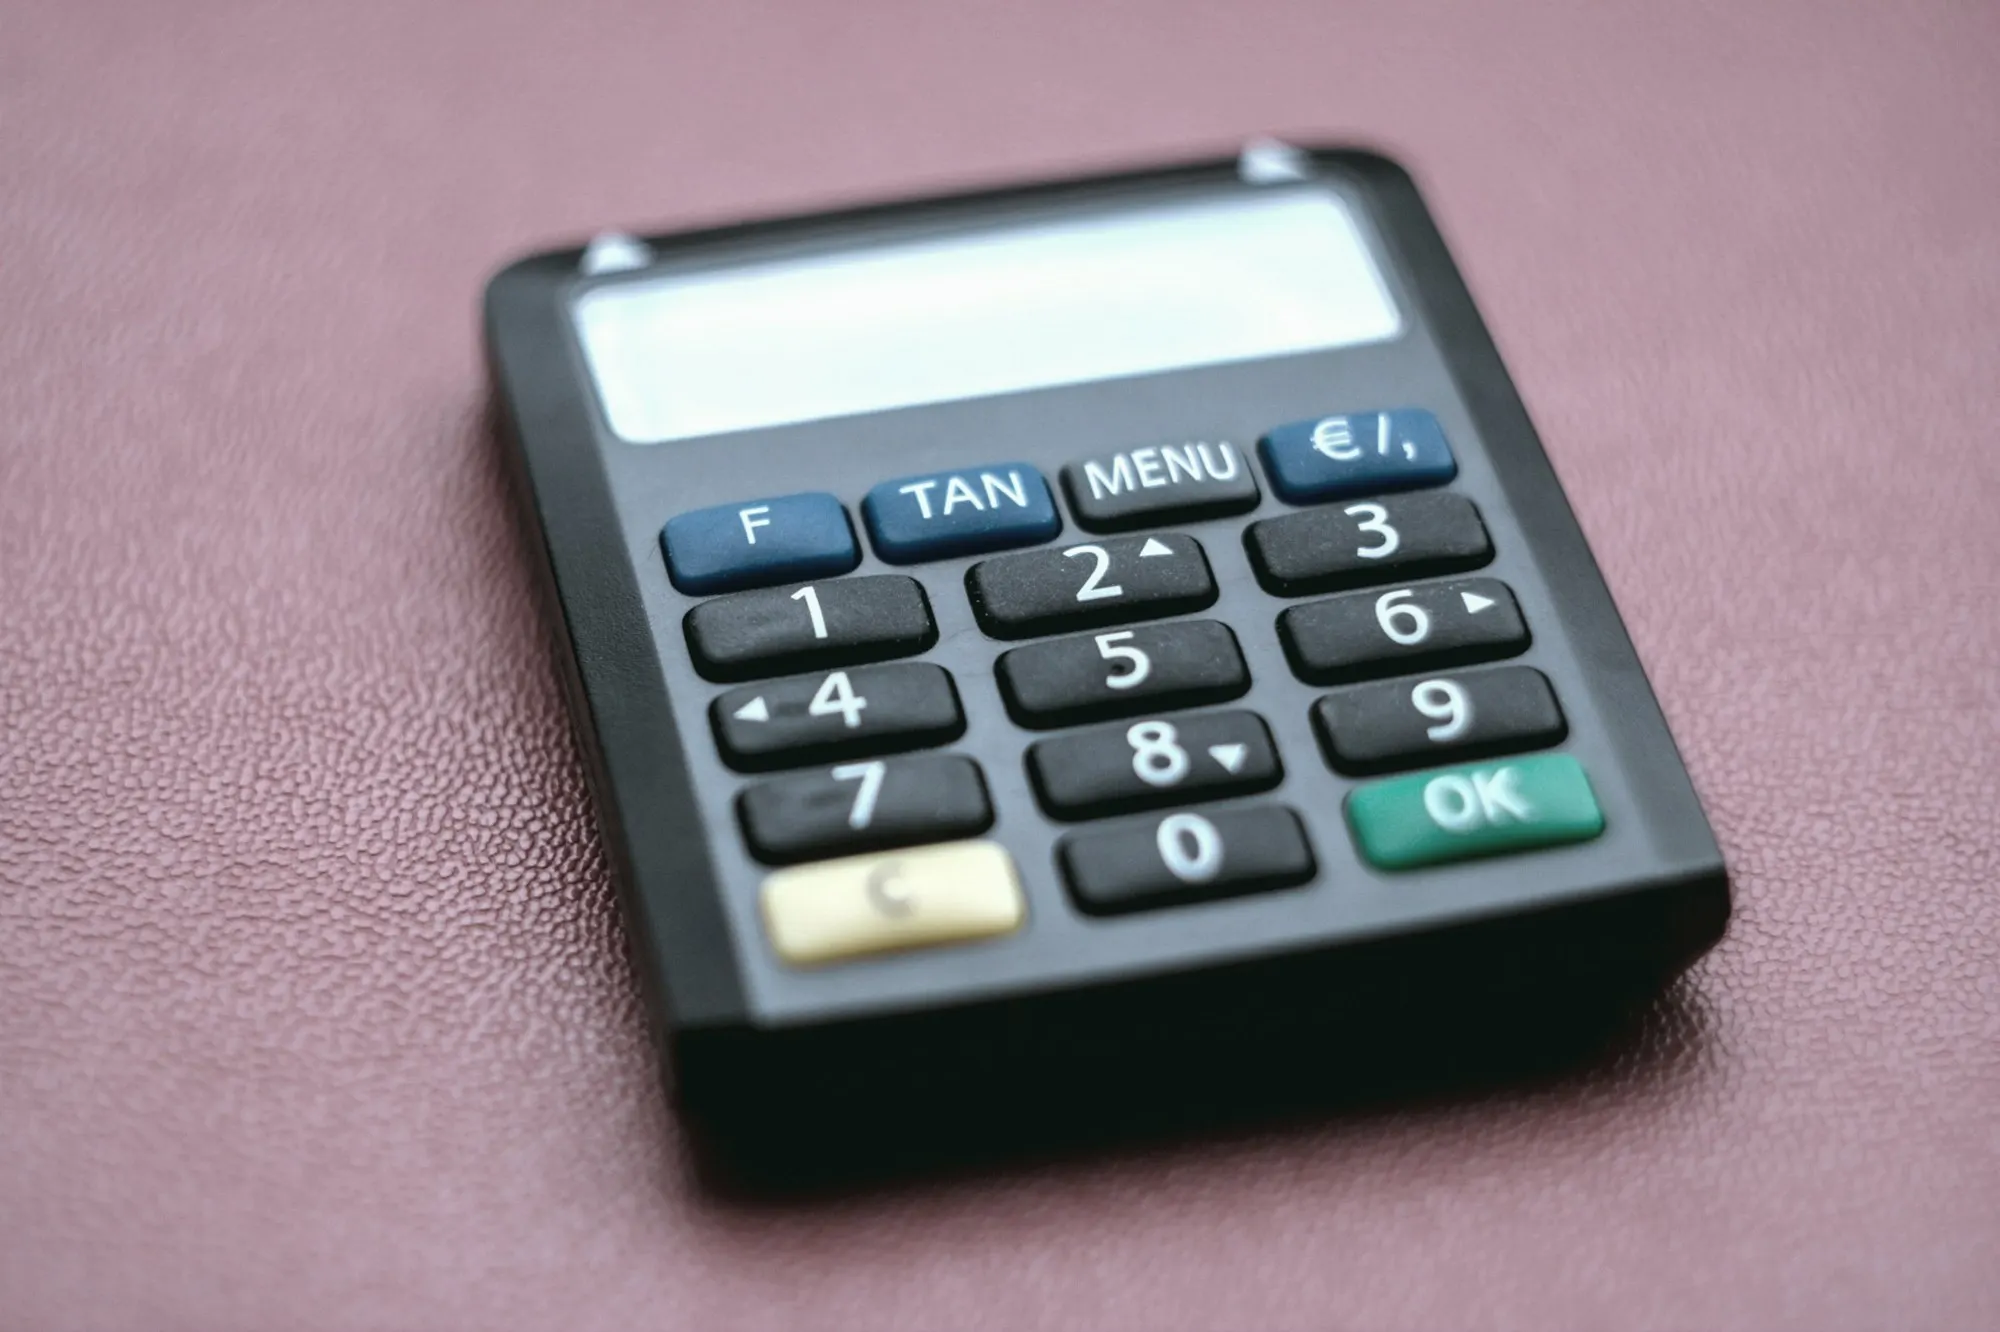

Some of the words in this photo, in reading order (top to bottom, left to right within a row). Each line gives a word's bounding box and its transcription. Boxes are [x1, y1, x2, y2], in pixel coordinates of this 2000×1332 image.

[899, 470, 1029, 519] TAN
[1083, 441, 1239, 500] MENU
[739, 505, 771, 545] F
[1344, 503, 1400, 559] 3
[1063, 544, 1123, 602] 2
[790, 585, 829, 639] 1
[1375, 589, 1430, 645] 6
[1095, 630, 1151, 689] 5
[809, 671, 867, 728] 4
[1411, 679, 1470, 741] 9
[1126, 720, 1190, 787] 8
[831, 760, 885, 830] 7
[1423, 766, 1532, 832] OK
[1156, 812, 1223, 883] 0
[866, 859, 917, 920] C
